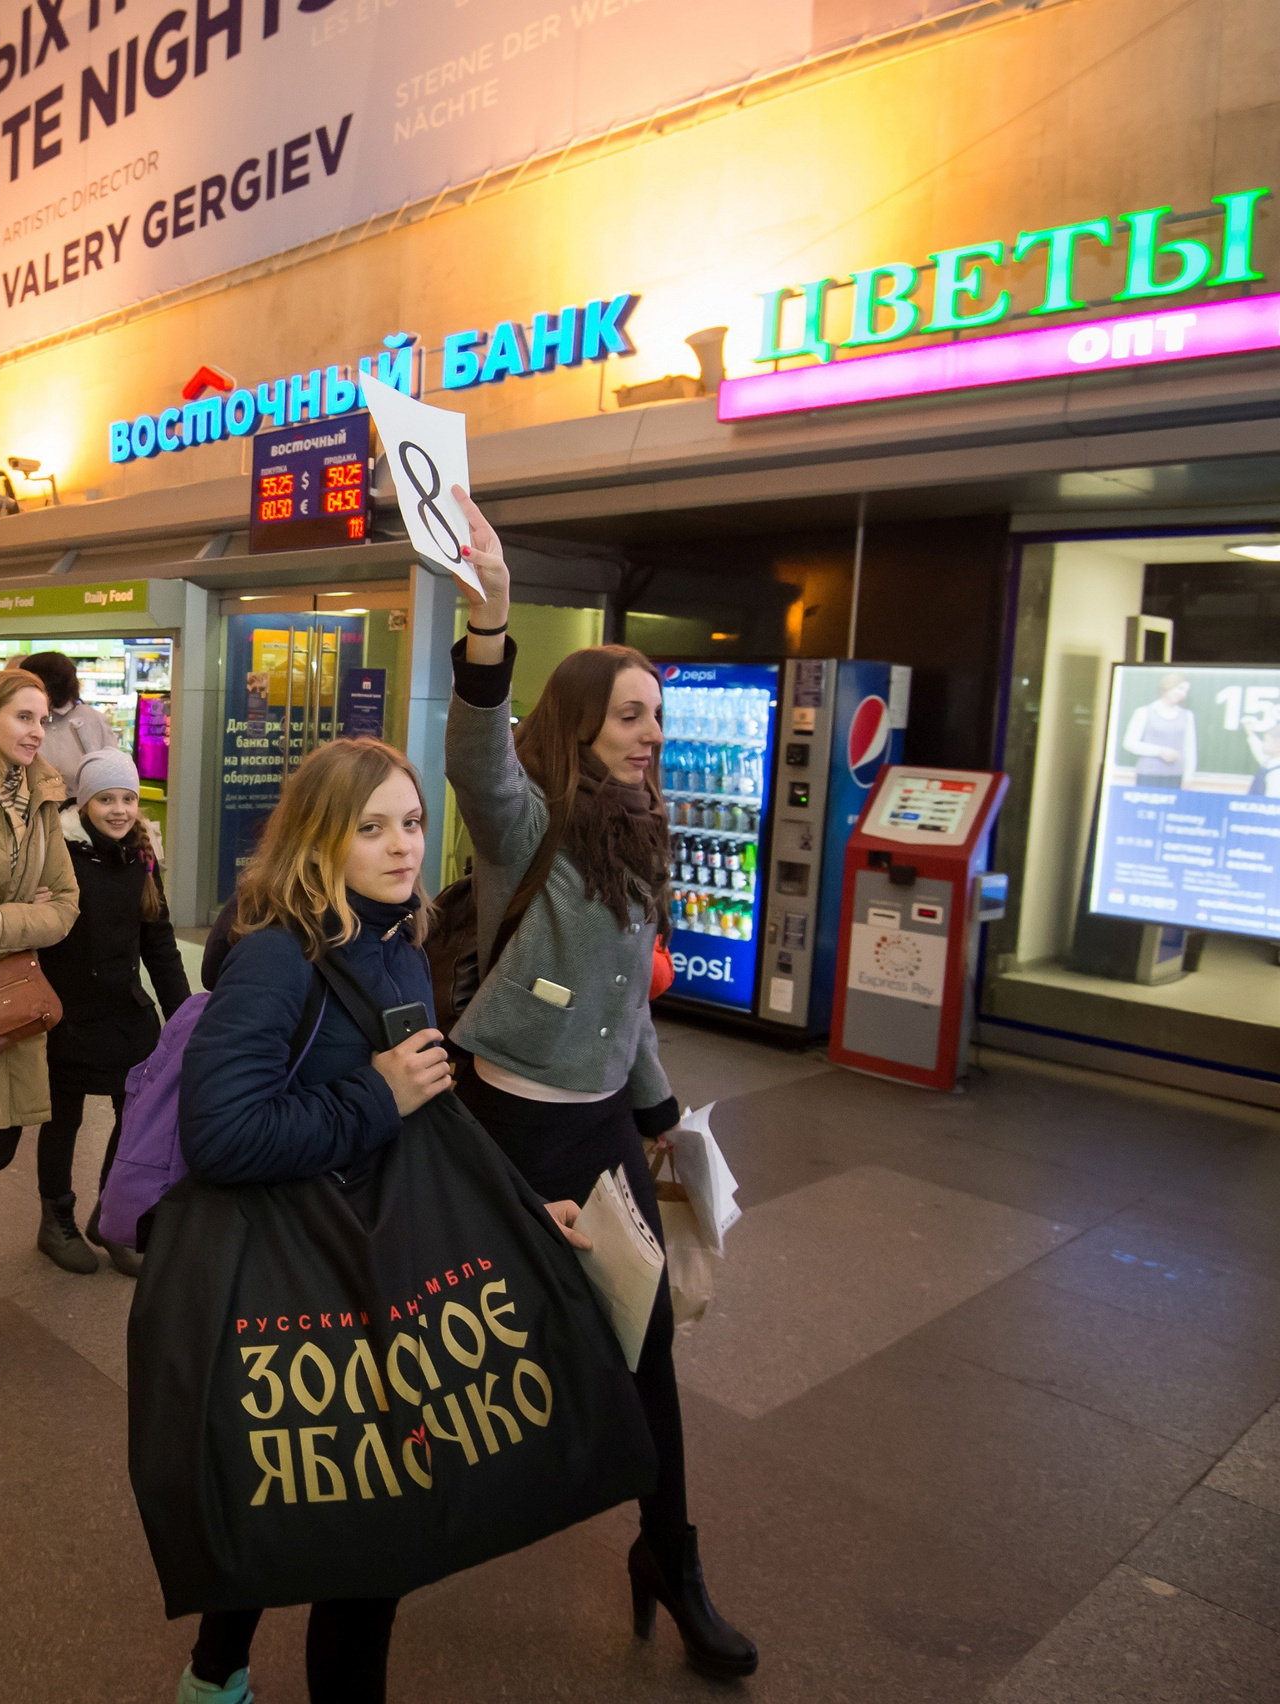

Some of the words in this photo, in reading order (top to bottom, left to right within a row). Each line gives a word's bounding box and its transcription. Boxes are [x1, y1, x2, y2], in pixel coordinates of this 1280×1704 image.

[79, 0, 336, 143] NIGH
[394, 41, 495, 109] STERNE
[502, 13, 562, 62] DER
[2, 197, 67, 248] ARTISTIC
[72, 150, 160, 213] DIRECTOR
[2, 214, 131, 309] VALERY
[143, 112, 354, 249] GERGIEV
[752, 186, 1271, 364] ЦВЕТЫ
[442, 291, 637, 392] БАНК
[1066, 313, 1197, 364] ОПТ
[260, 465, 288, 476] ПОКУПКА
[324, 453, 358, 466] ПРОДАЖА
[398, 440, 462, 564] 8
[15, 596, 34, 607] Food
[84, 591, 107, 606] Daily
[109, 588, 133, 602] Food
[682, 669, 717, 681] pepsi
[226, 719, 248, 733] Для
[320, 721, 344, 731] кат
[1215, 685, 1280, 733] 15
[224, 756, 238, 766] на
[236, 736, 269, 748] банка
[223, 771, 283, 785] оборудован
[671, 952, 733, 982] epsi
[859, 971, 908, 992] Express
[390, 1257, 493, 1321] АНМБЛЬ
[249, 1358, 553, 1505] ЯБЛОЧКО
